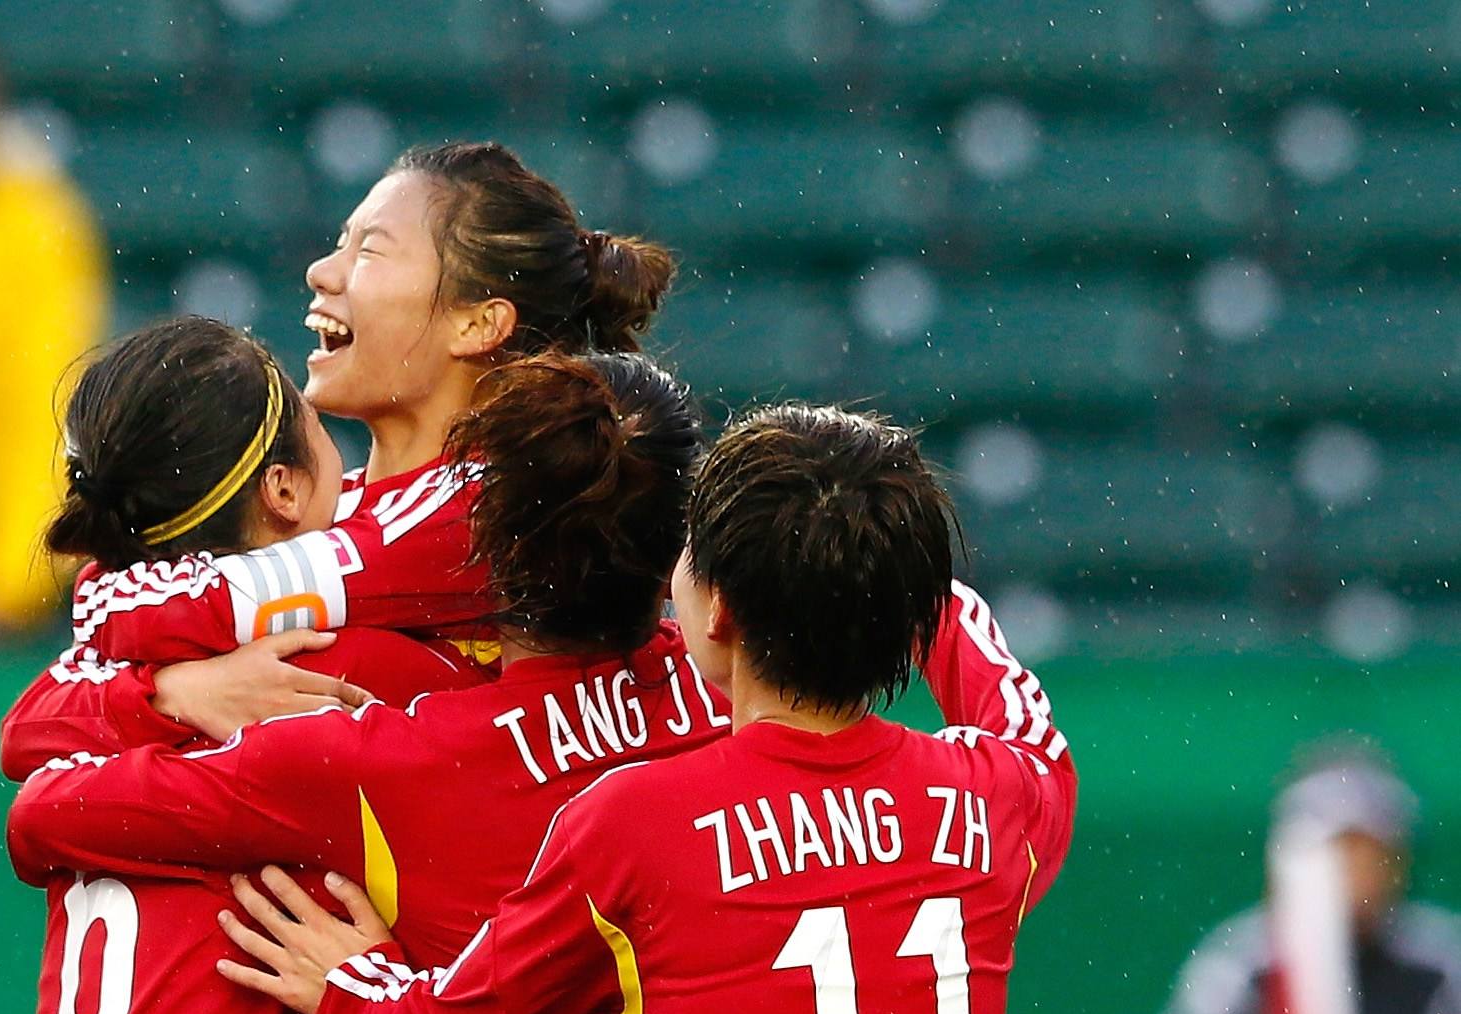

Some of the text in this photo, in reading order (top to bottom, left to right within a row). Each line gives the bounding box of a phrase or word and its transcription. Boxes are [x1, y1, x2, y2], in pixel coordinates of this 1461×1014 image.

[492, 668, 648, 784] TANG
[693, 786, 991, 893] ZHANG ZH
